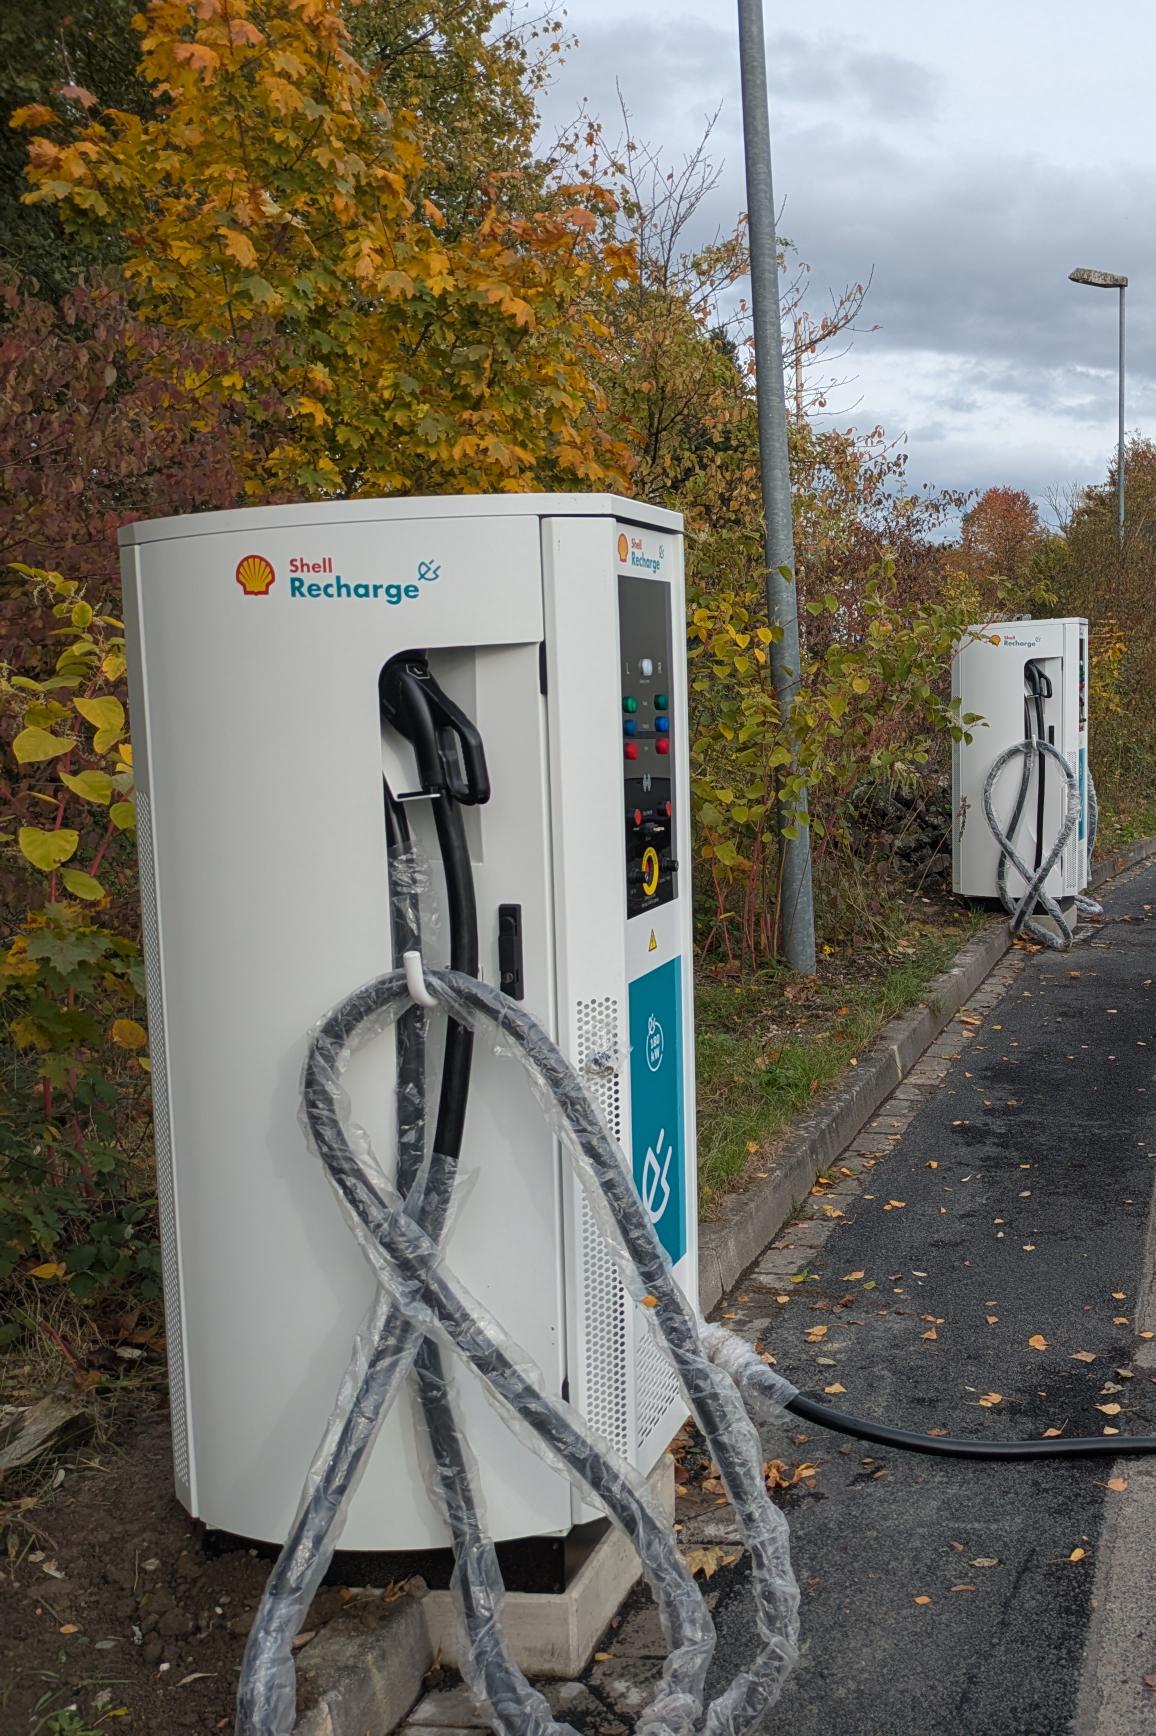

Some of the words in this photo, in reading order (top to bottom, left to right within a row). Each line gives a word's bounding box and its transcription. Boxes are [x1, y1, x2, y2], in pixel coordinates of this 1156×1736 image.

[631, 537, 642, 550] Shell
[289, 557, 333, 573] Shell
[631, 551, 660, 574] Recharge
[290, 575, 420, 605] Recharge
[650, 1033, 660, 1049] 180
